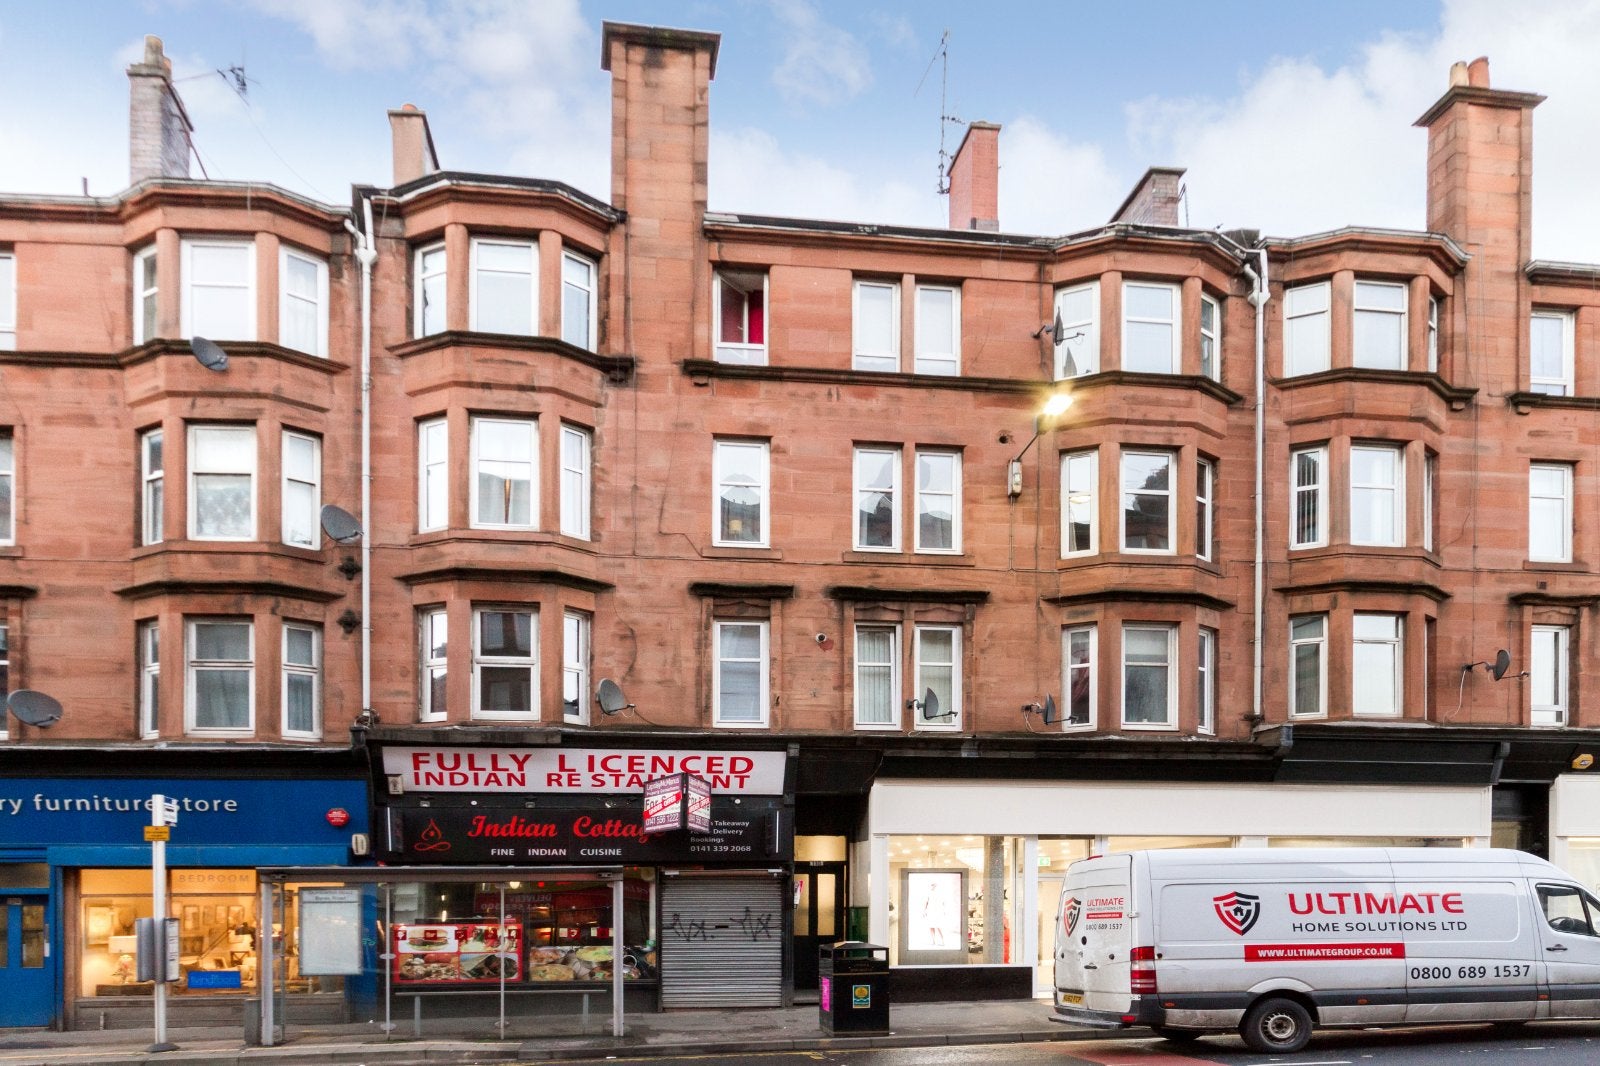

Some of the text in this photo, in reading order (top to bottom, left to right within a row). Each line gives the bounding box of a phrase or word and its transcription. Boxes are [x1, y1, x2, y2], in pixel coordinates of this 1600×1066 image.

[411, 752, 754, 775] FULLY LICENCED
[413, 771, 526, 787] INDIAN
[33, 794, 153, 811] furniture
[174, 796, 238, 811] tore
[468, 815, 558, 837] Indian
[573, 815, 667, 844] Cottag
[690, 836, 725, 844] Bookings
[491, 848, 622, 856] FINE INDIAN CUISINE
[179, 874, 249, 883] BEDROOM
[1087, 897, 1124, 907] ULTIMATE
[1288, 892, 1465, 915] ULTIMATE
[1292, 921, 1468, 932] HOME SOLUTIONS LTD
[1258, 947, 1393, 958] WWW.ULTIMATEGROUP.CO.UK
[1410, 964, 1530, 979] 0800 689 1537
